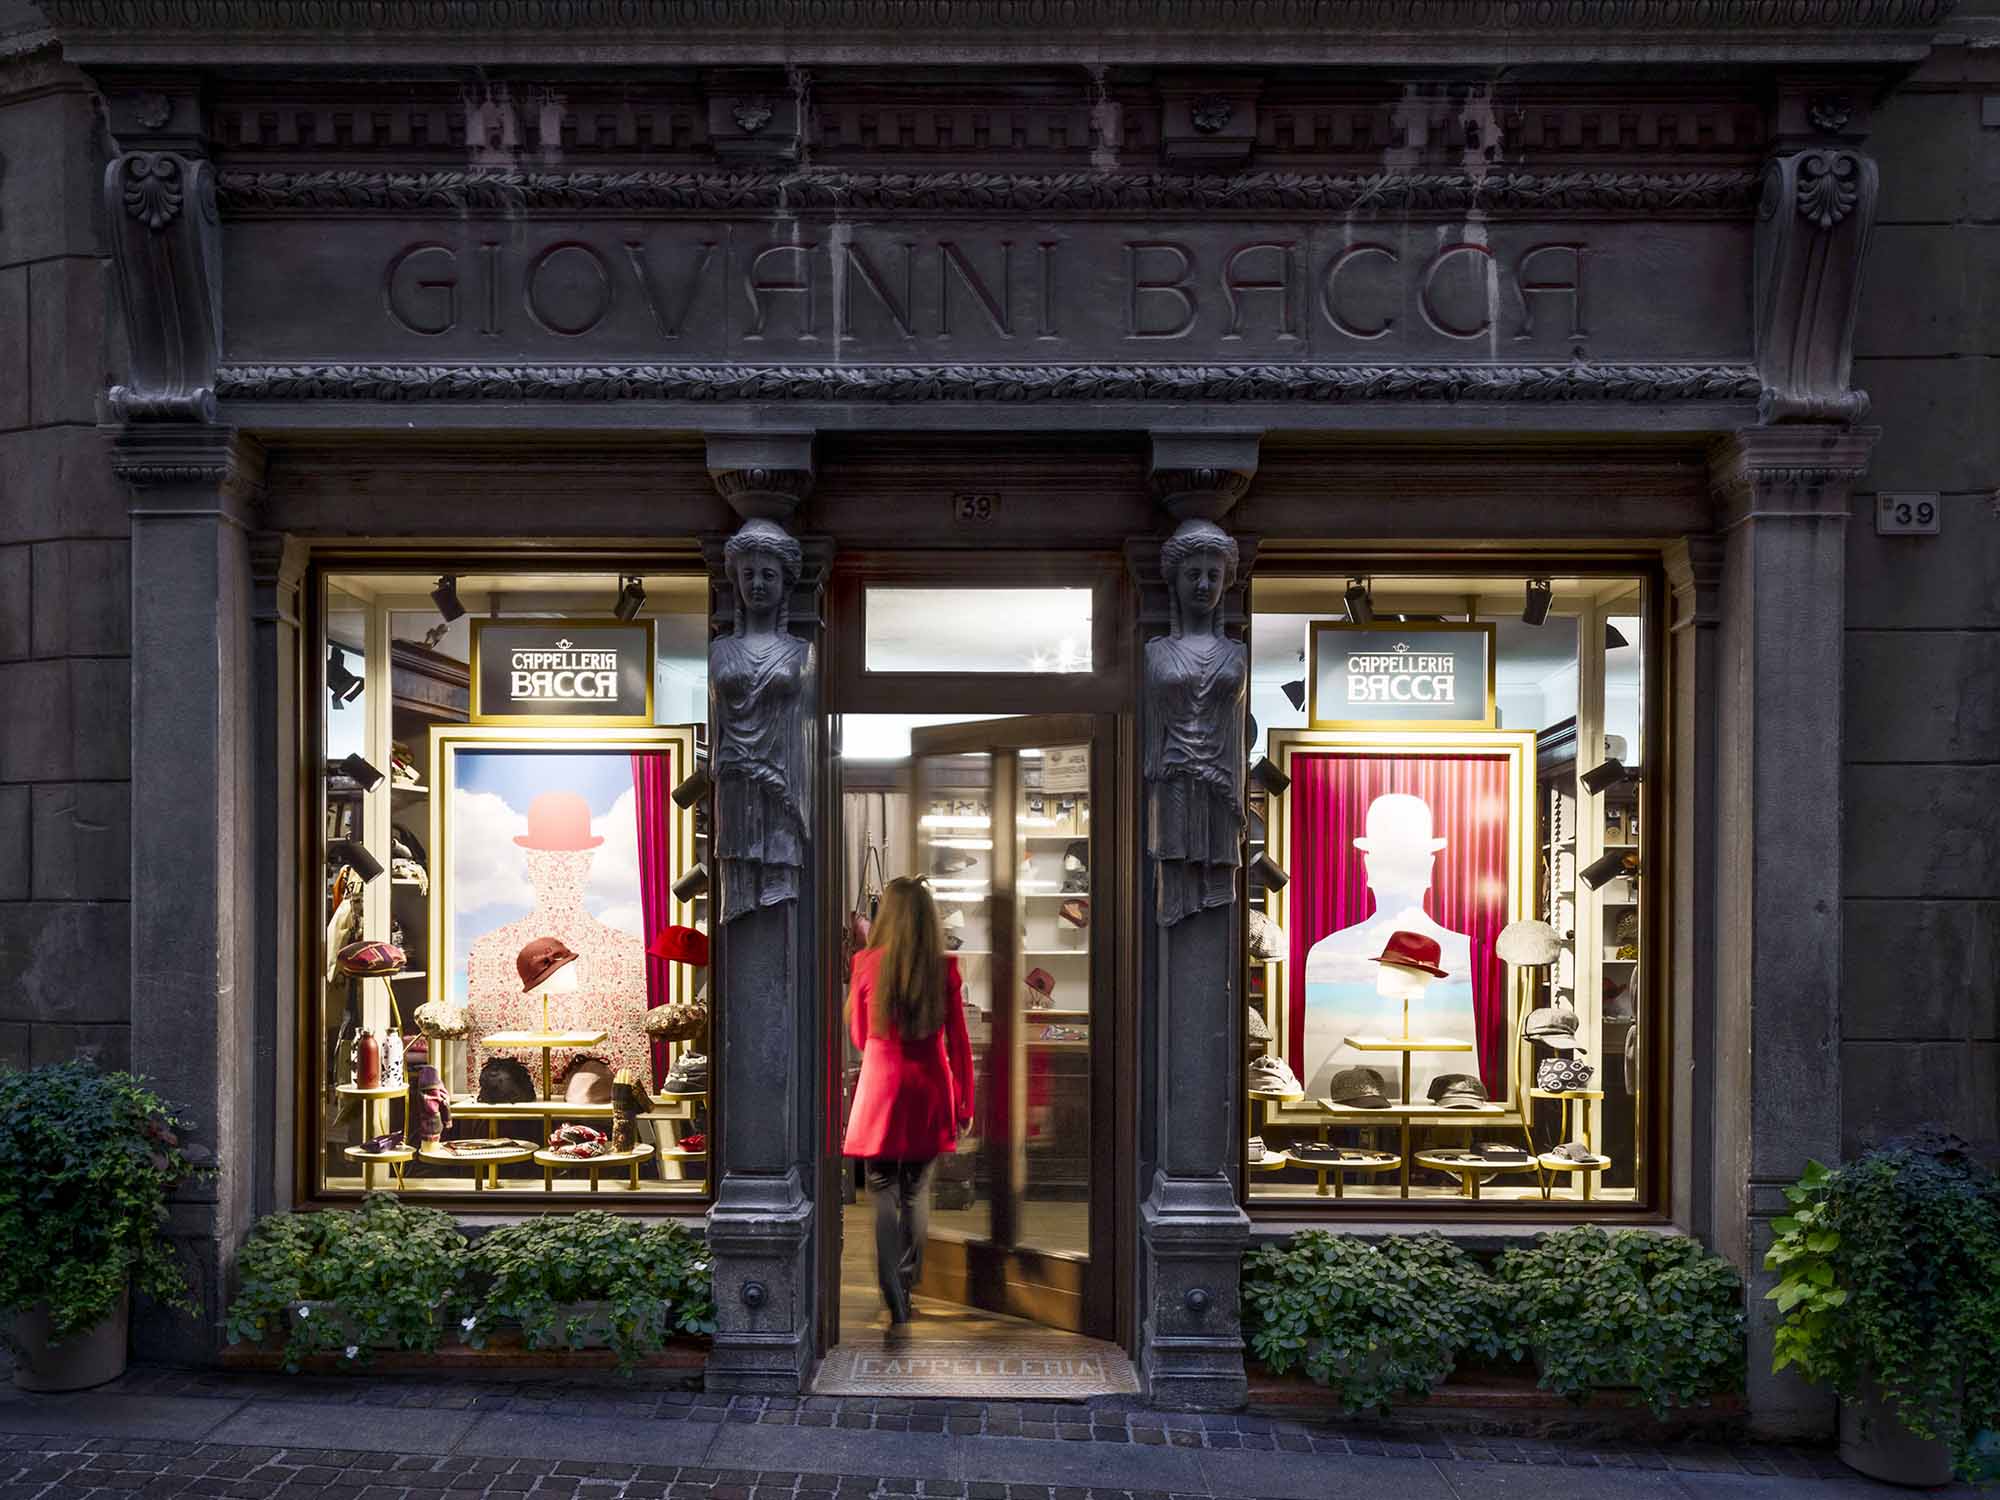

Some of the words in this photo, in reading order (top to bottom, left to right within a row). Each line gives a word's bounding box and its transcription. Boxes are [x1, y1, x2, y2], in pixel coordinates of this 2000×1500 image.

[382, 239, 1064, 341] GIOVANNI
[1121, 240, 1590, 342] BACCA
[961, 495, 992, 521] 39
[1895, 502, 1935, 525] 39
[511, 653, 617, 670] CAPPELLERIA
[1347, 656, 1454, 673] CAPPELLERIA
[511, 671, 618, 697] BACCA
[1347, 674, 1455, 701] BACCA
[862, 1359, 1098, 1377] CAPPELLERIA
